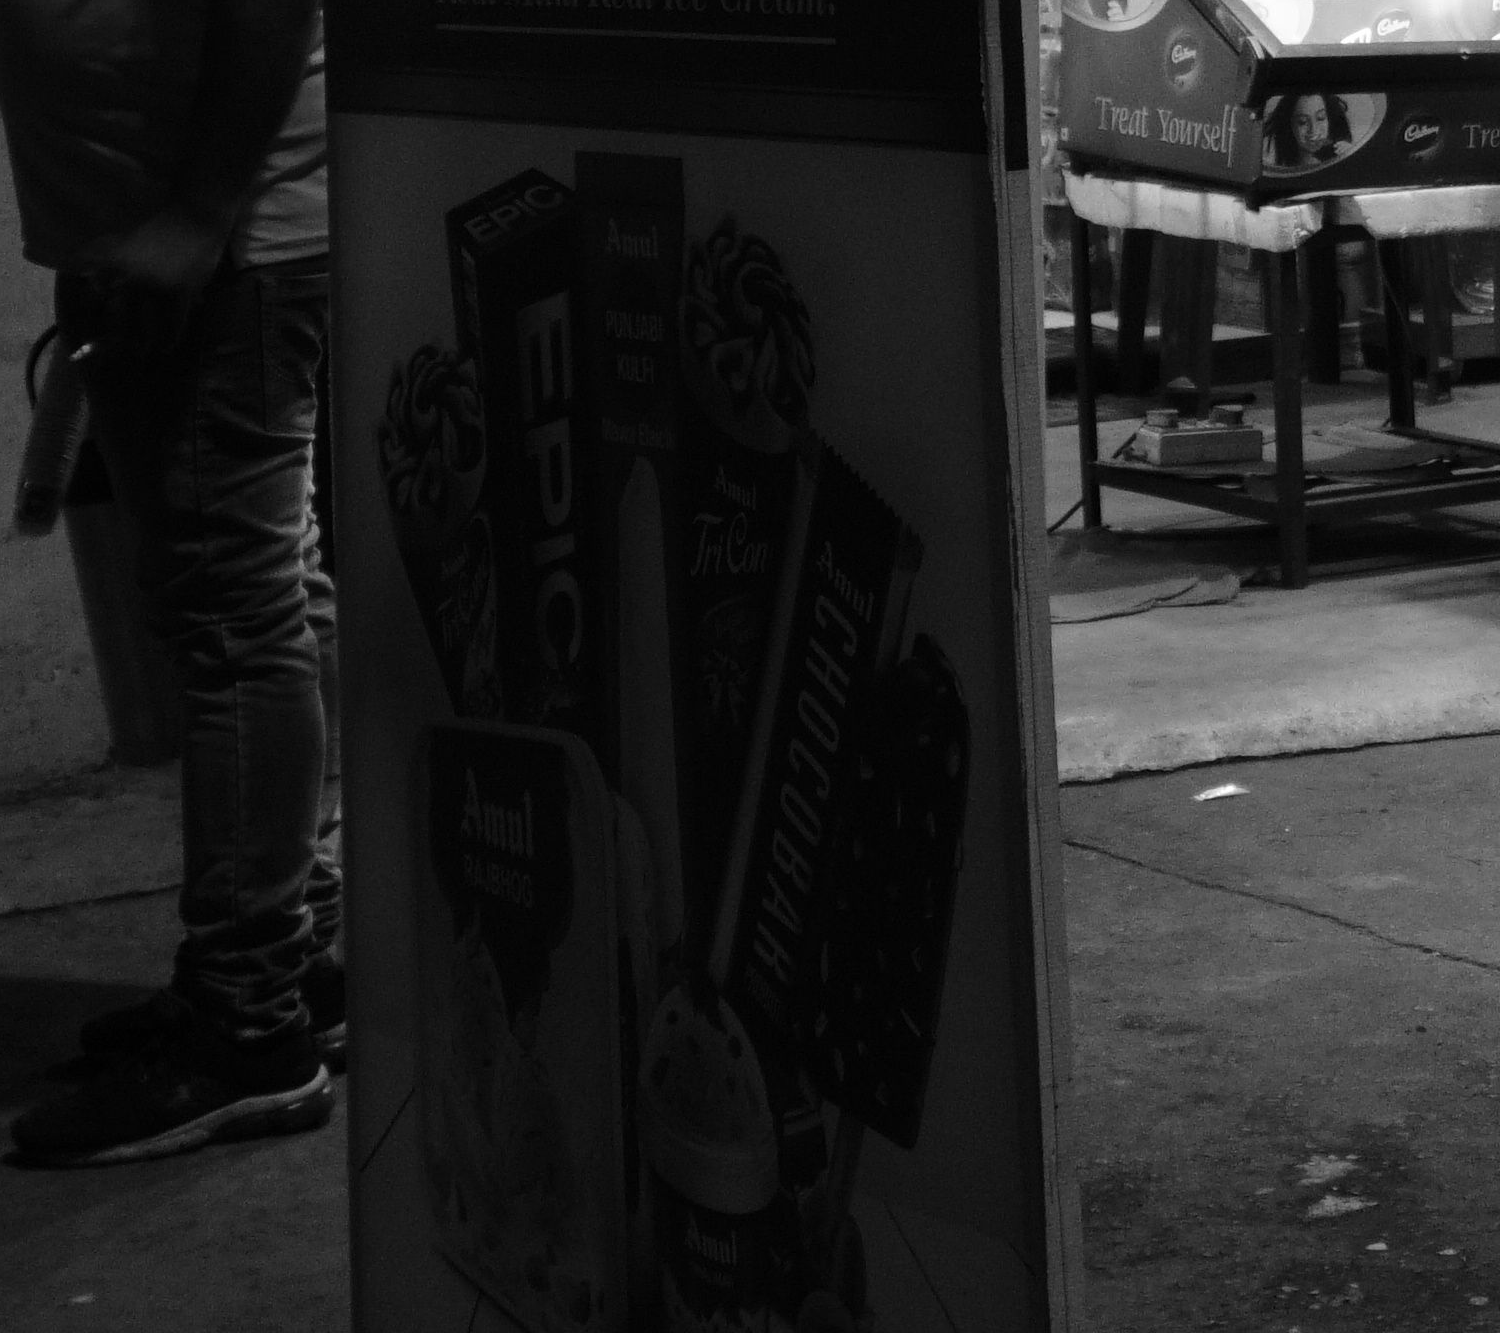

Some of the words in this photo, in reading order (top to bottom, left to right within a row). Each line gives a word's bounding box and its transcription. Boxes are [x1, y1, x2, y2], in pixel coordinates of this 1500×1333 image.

[1095, 96, 1149, 139] Treat
[1157, 104, 1239, 169] Yourself
[463, 184, 564, 245] EPIC
[604, 216, 660, 260] Amul
[460, 765, 535, 860] Amul
